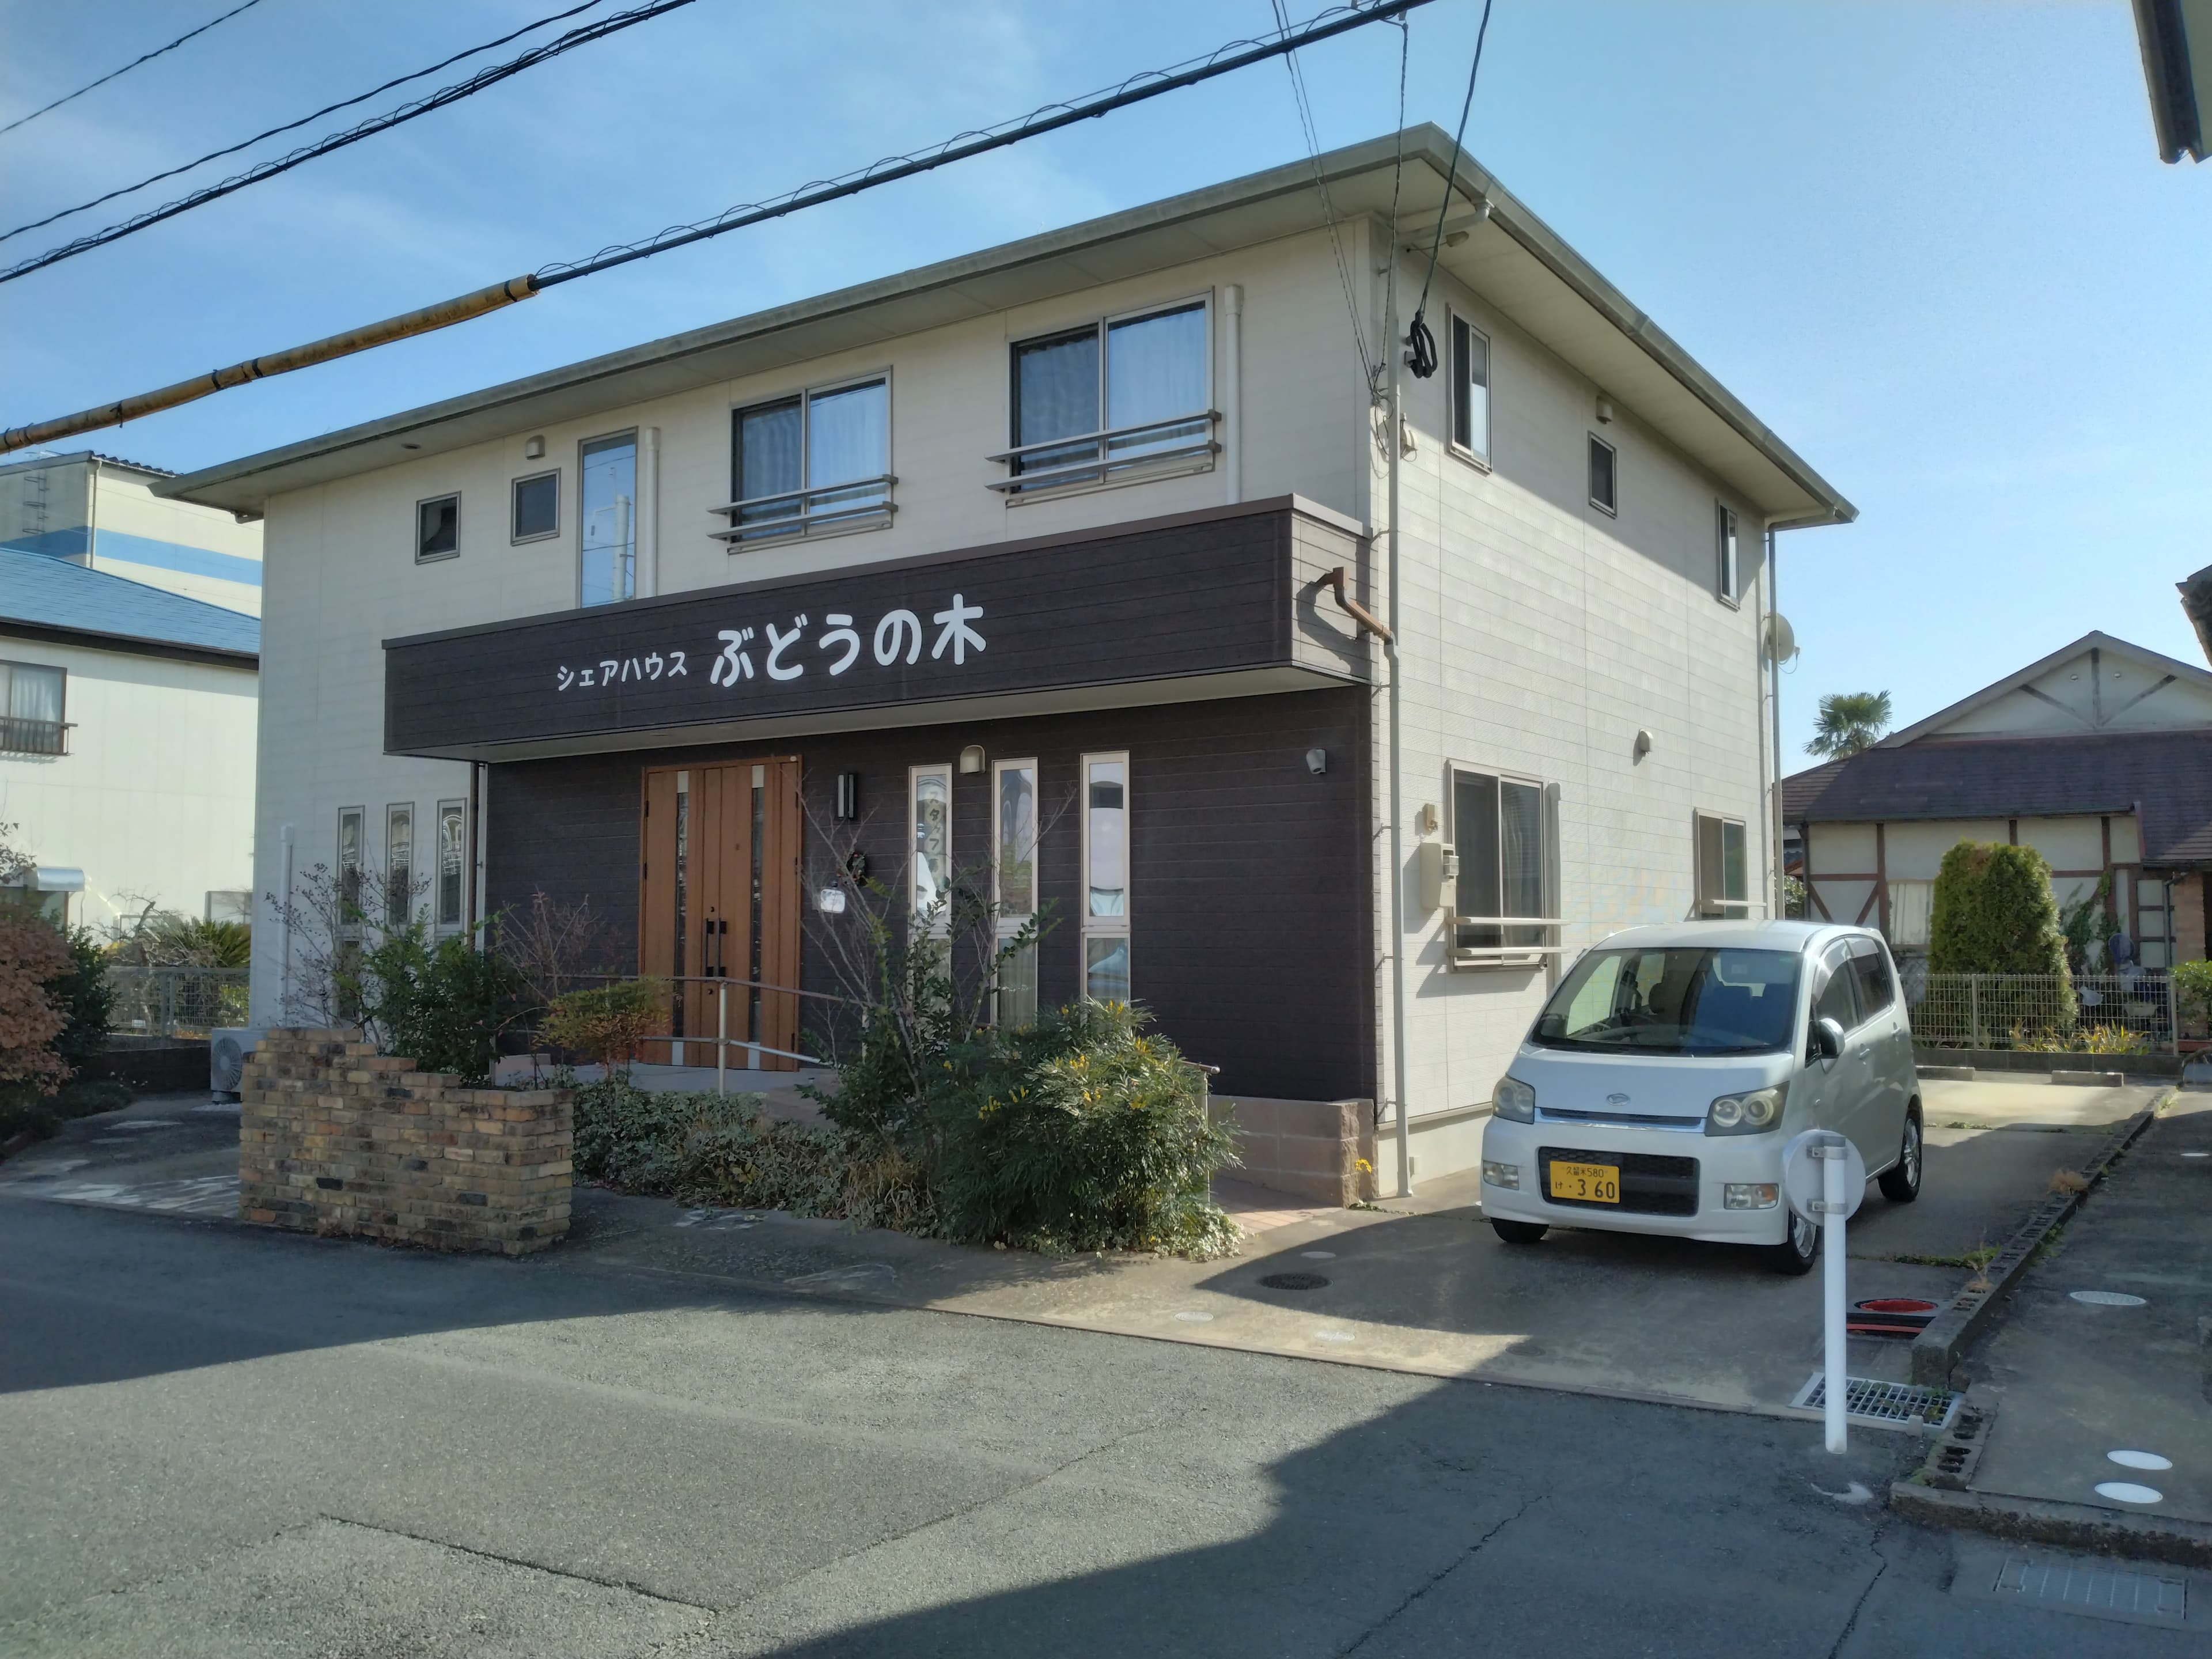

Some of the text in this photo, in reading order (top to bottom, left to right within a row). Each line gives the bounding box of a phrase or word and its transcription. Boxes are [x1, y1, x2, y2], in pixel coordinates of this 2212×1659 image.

[557, 593, 987, 691] シェアハウス ぶどうの木
